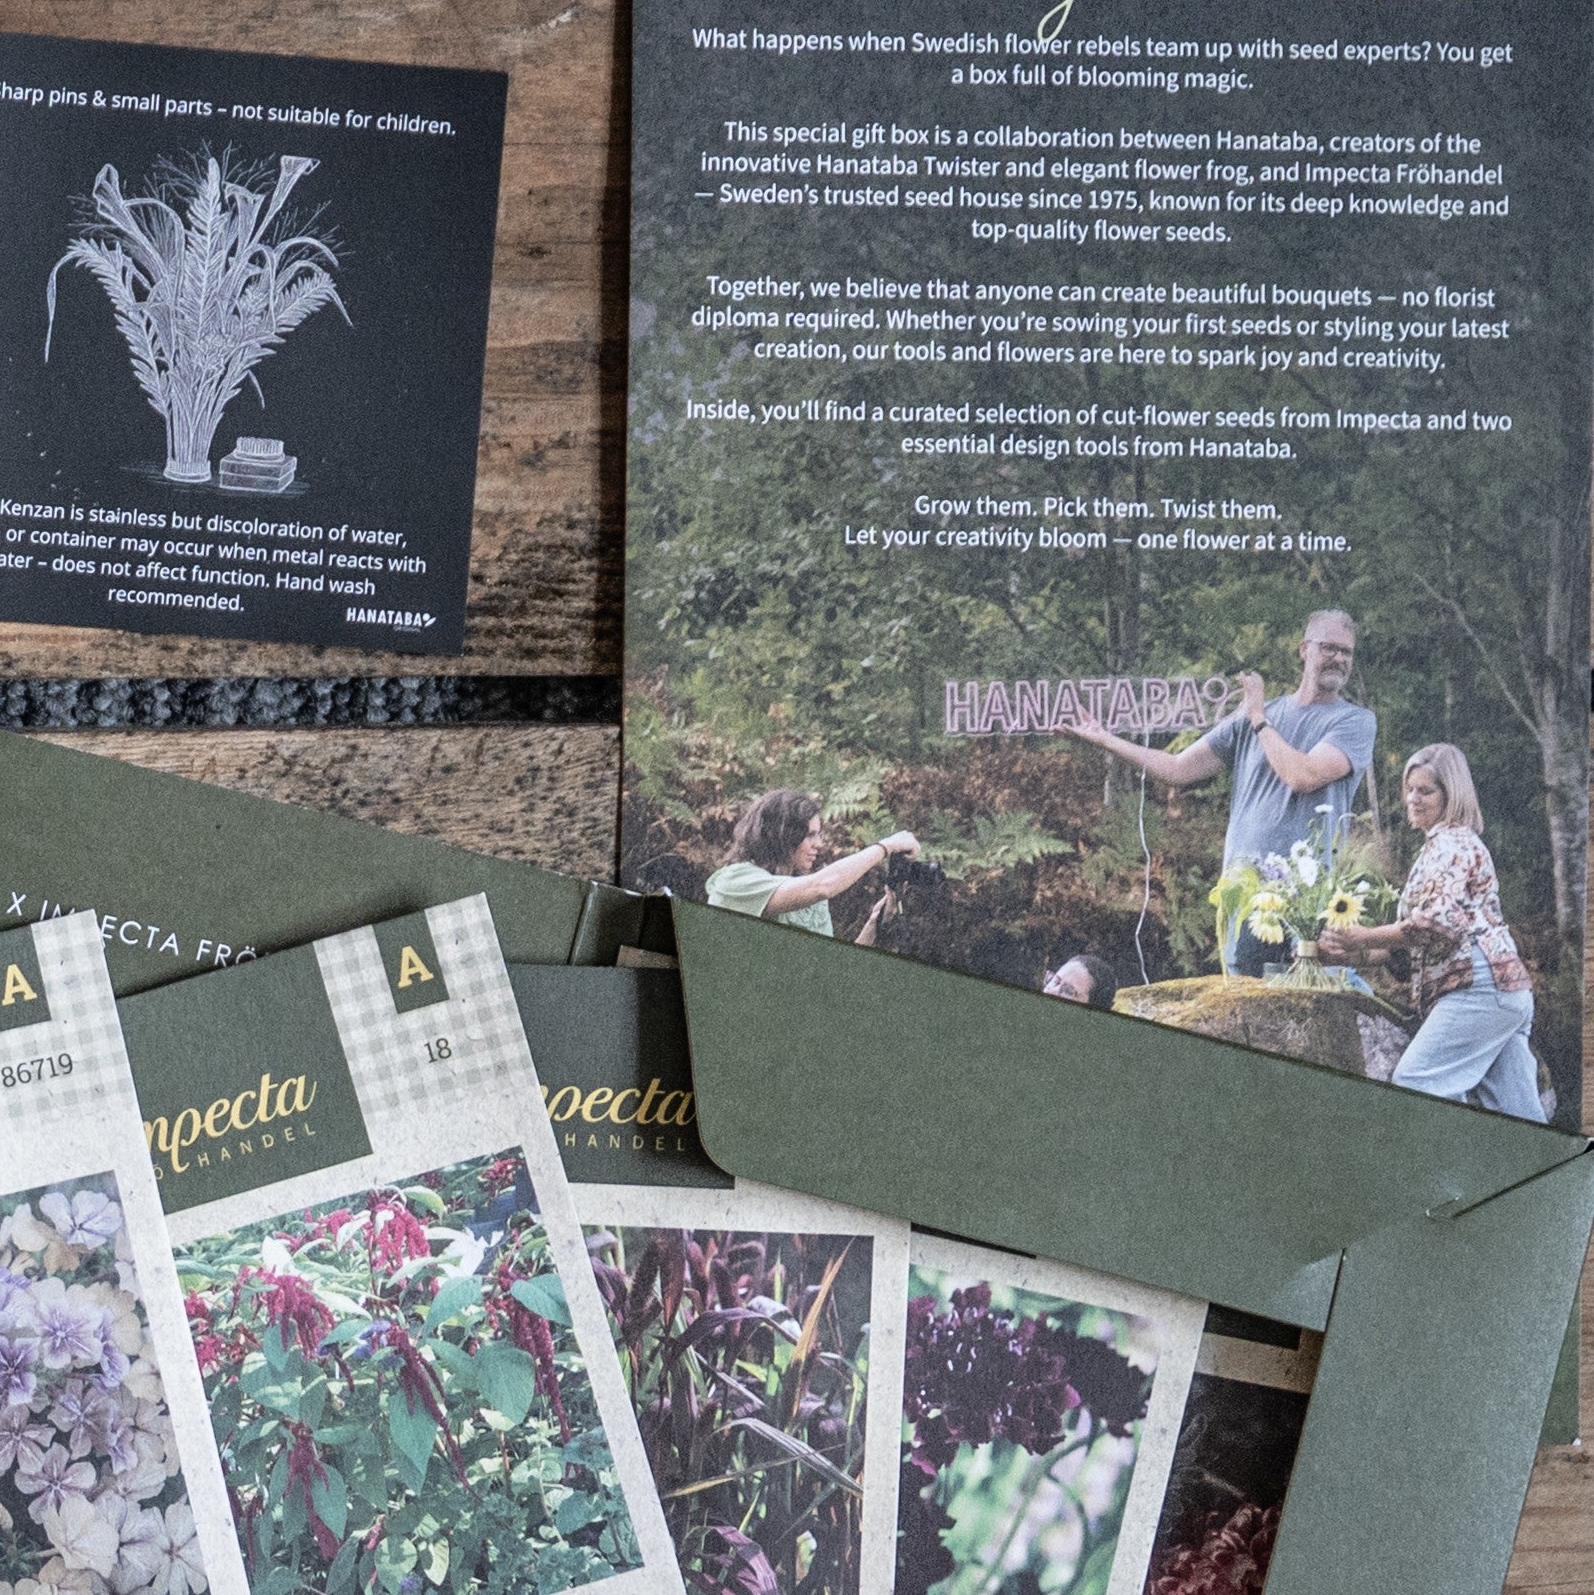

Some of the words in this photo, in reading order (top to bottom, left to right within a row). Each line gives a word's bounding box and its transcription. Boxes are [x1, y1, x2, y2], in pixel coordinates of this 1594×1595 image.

[48, 86, 88, 108] pins
[91, 89, 107, 108] &
[110, 93, 161, 112] small
[164, 98, 213, 118] parts
[231, 104, 264, 121] not
[267, 104, 341, 127] suitable
[344, 108, 373, 129] for
[375, 112, 457, 136] children.
[0, 498, 66, 520] Kenzan
[69, 503, 85, 522] is
[88, 507, 167, 529] stainless
[170, 510, 203, 531] but
[206, 514, 324, 540] discoloration
[327, 523, 349, 542] of
[350, 529, 407, 549] water,
[914, 495, 972, 518] Grow
[975, 494, 1038, 517] them.
[1043, 495, 1088, 518] Pick
[1092, 496, 1155, 520] them.
[1160, 498, 1216, 520] Twist
[1220, 498, 1283, 521] them.
[5, 528, 27, 543] or
[29, 530, 117, 550] container
[120, 537, 160, 558] may
[163, 540, 215, 558] occur
[217, 542, 268, 562] when
[271, 548, 324, 566] metal
[328, 553, 384, 571] reacts
[387, 555, 427, 574] with
[51, 554, 96, 575] does
[100, 561, 132, 577] not
[134, 561, 188, 582] affect
[191, 564, 270, 589] function.
[275, 572, 325, 592] Hand
[328, 577, 376, 596] wash
[107, 588, 245, 612] recommended.
[346, 607, 423, 626] HANATABA
[946, 678, 1209, 734] HANATABA
[6, 891, 27, 917] X
[40, 900, 179, 956] IECTA
[1, 964, 38, 1006] A
[397, 945, 436, 990] A
[0, 1053, 76, 1089] 86719
[424, 1037, 452, 1064] 18
[143, 1073, 318, 1173] mpecta
[565, 1133, 686, 1151] HANDEL
